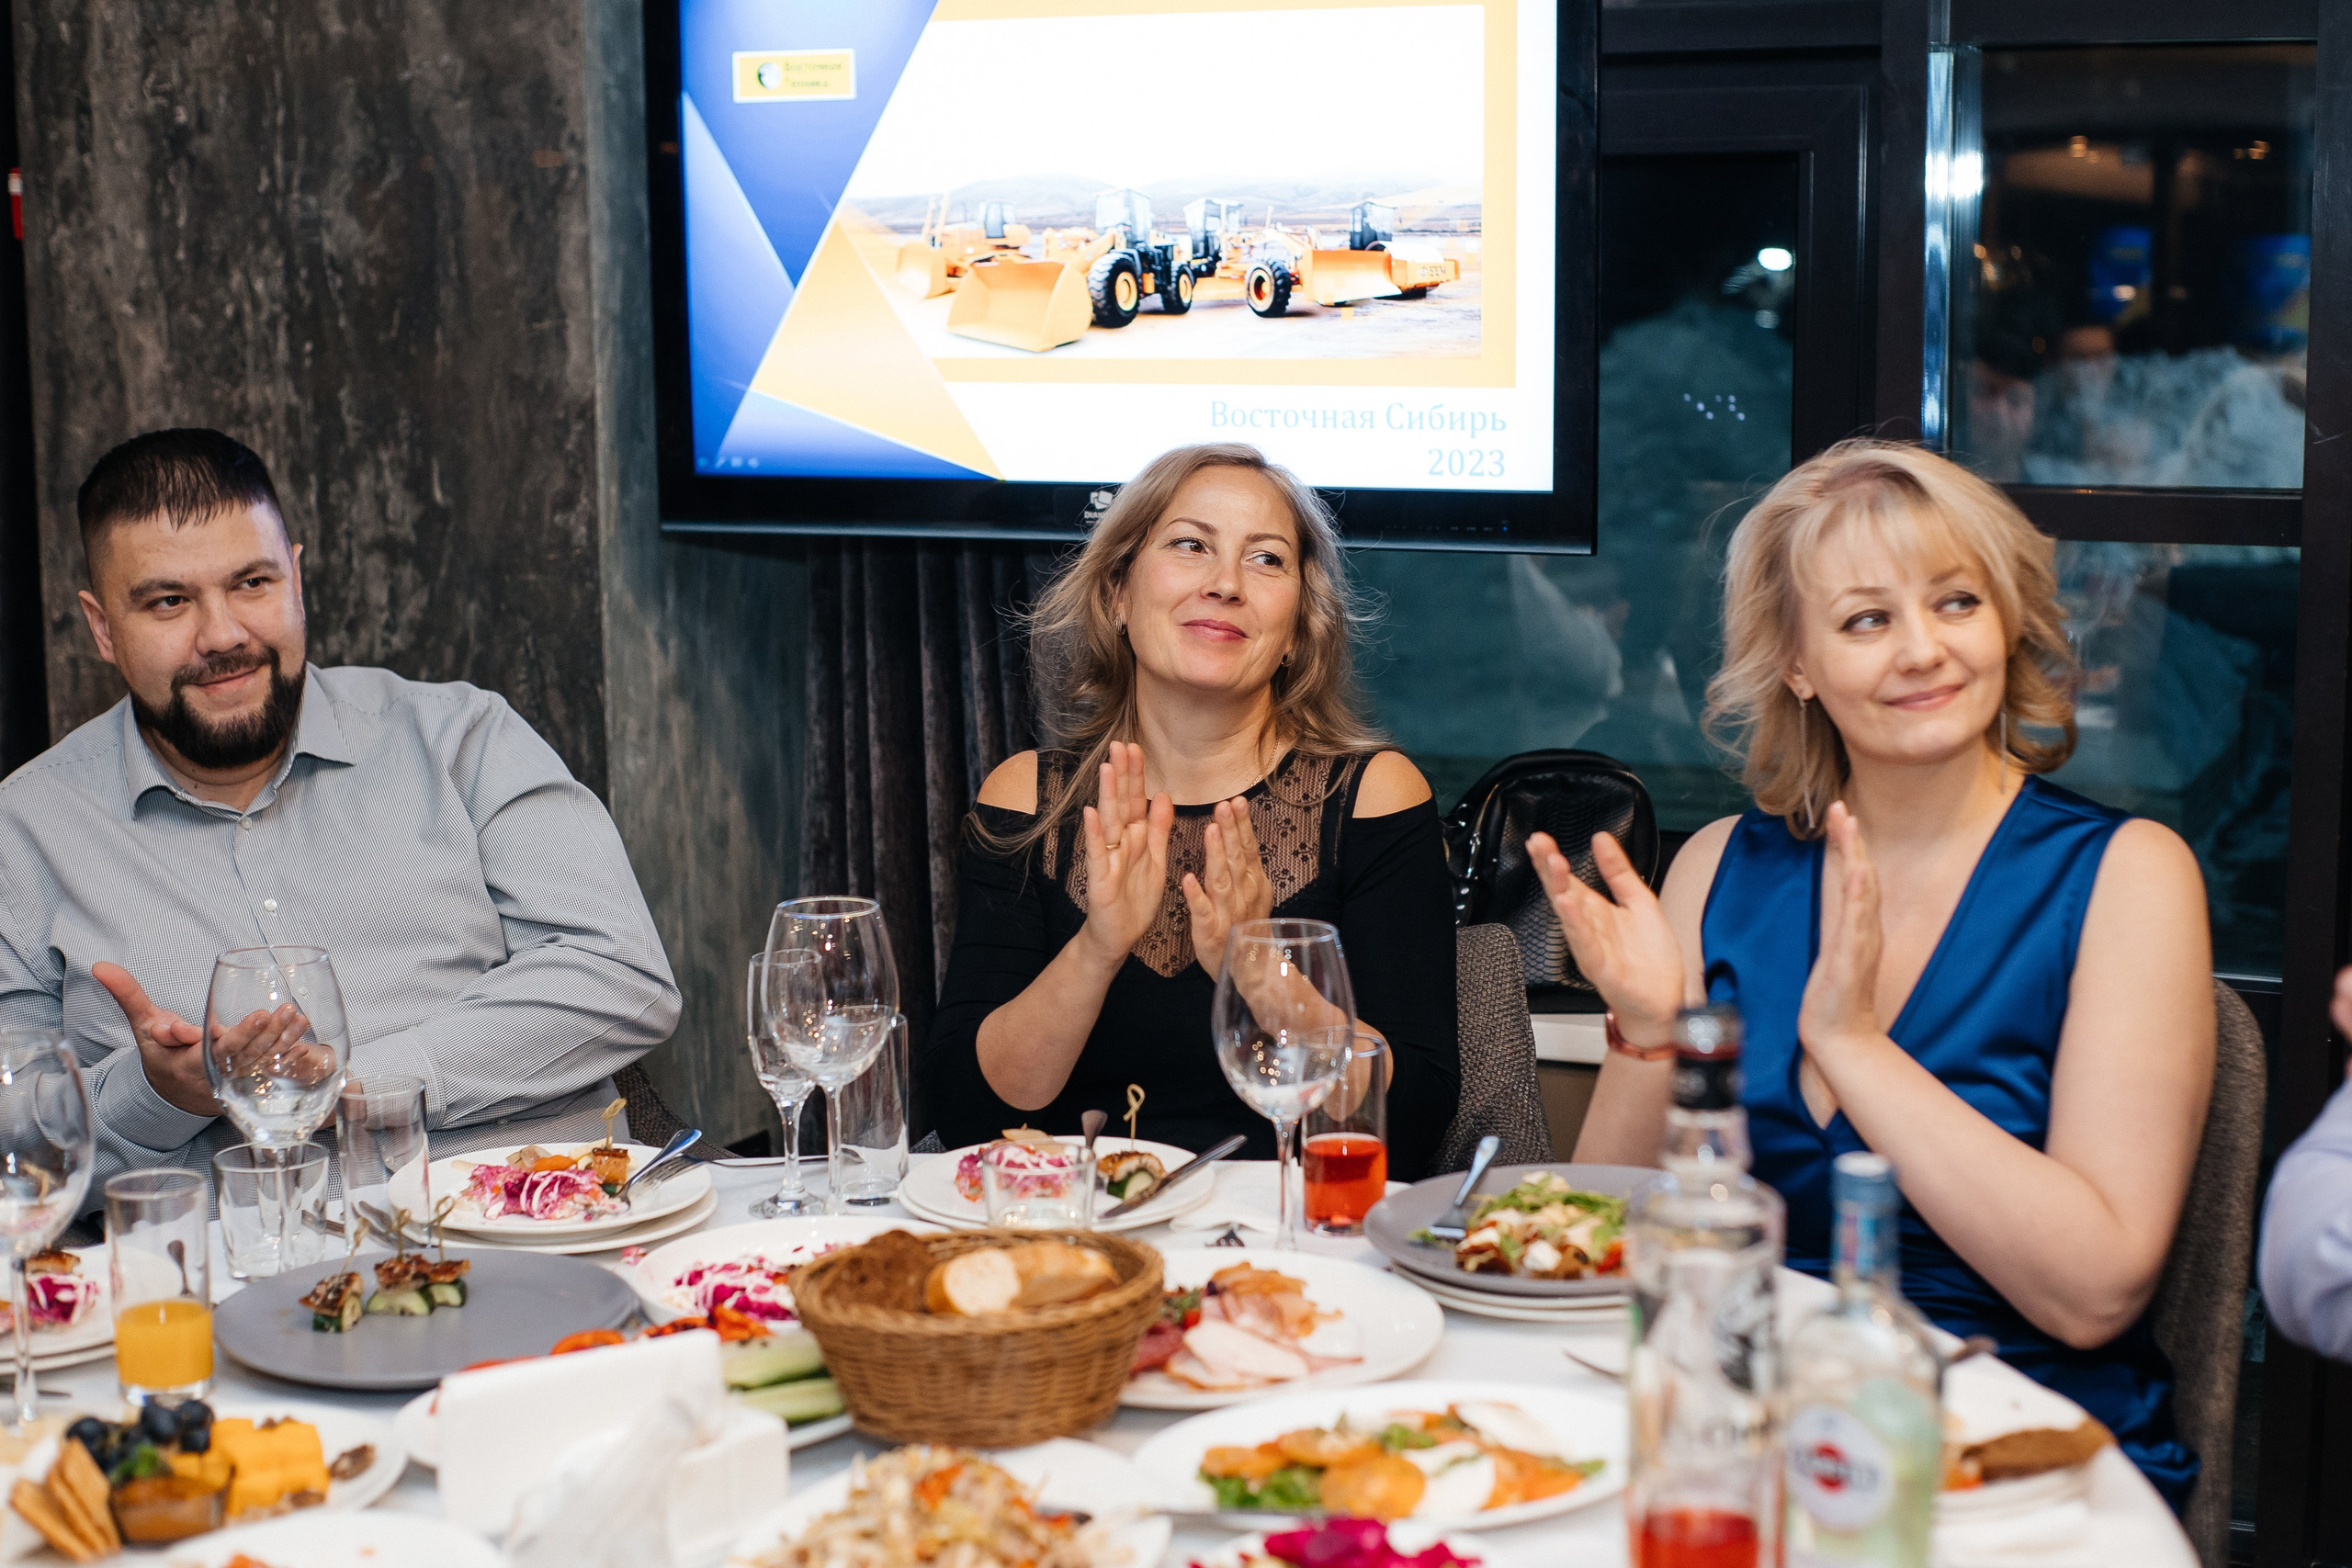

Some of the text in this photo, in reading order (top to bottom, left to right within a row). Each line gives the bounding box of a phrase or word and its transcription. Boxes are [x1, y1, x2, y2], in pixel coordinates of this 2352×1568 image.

[1211, 400, 1508, 439] Восточная Сибирь
[1428, 448, 1506, 478] 2023
